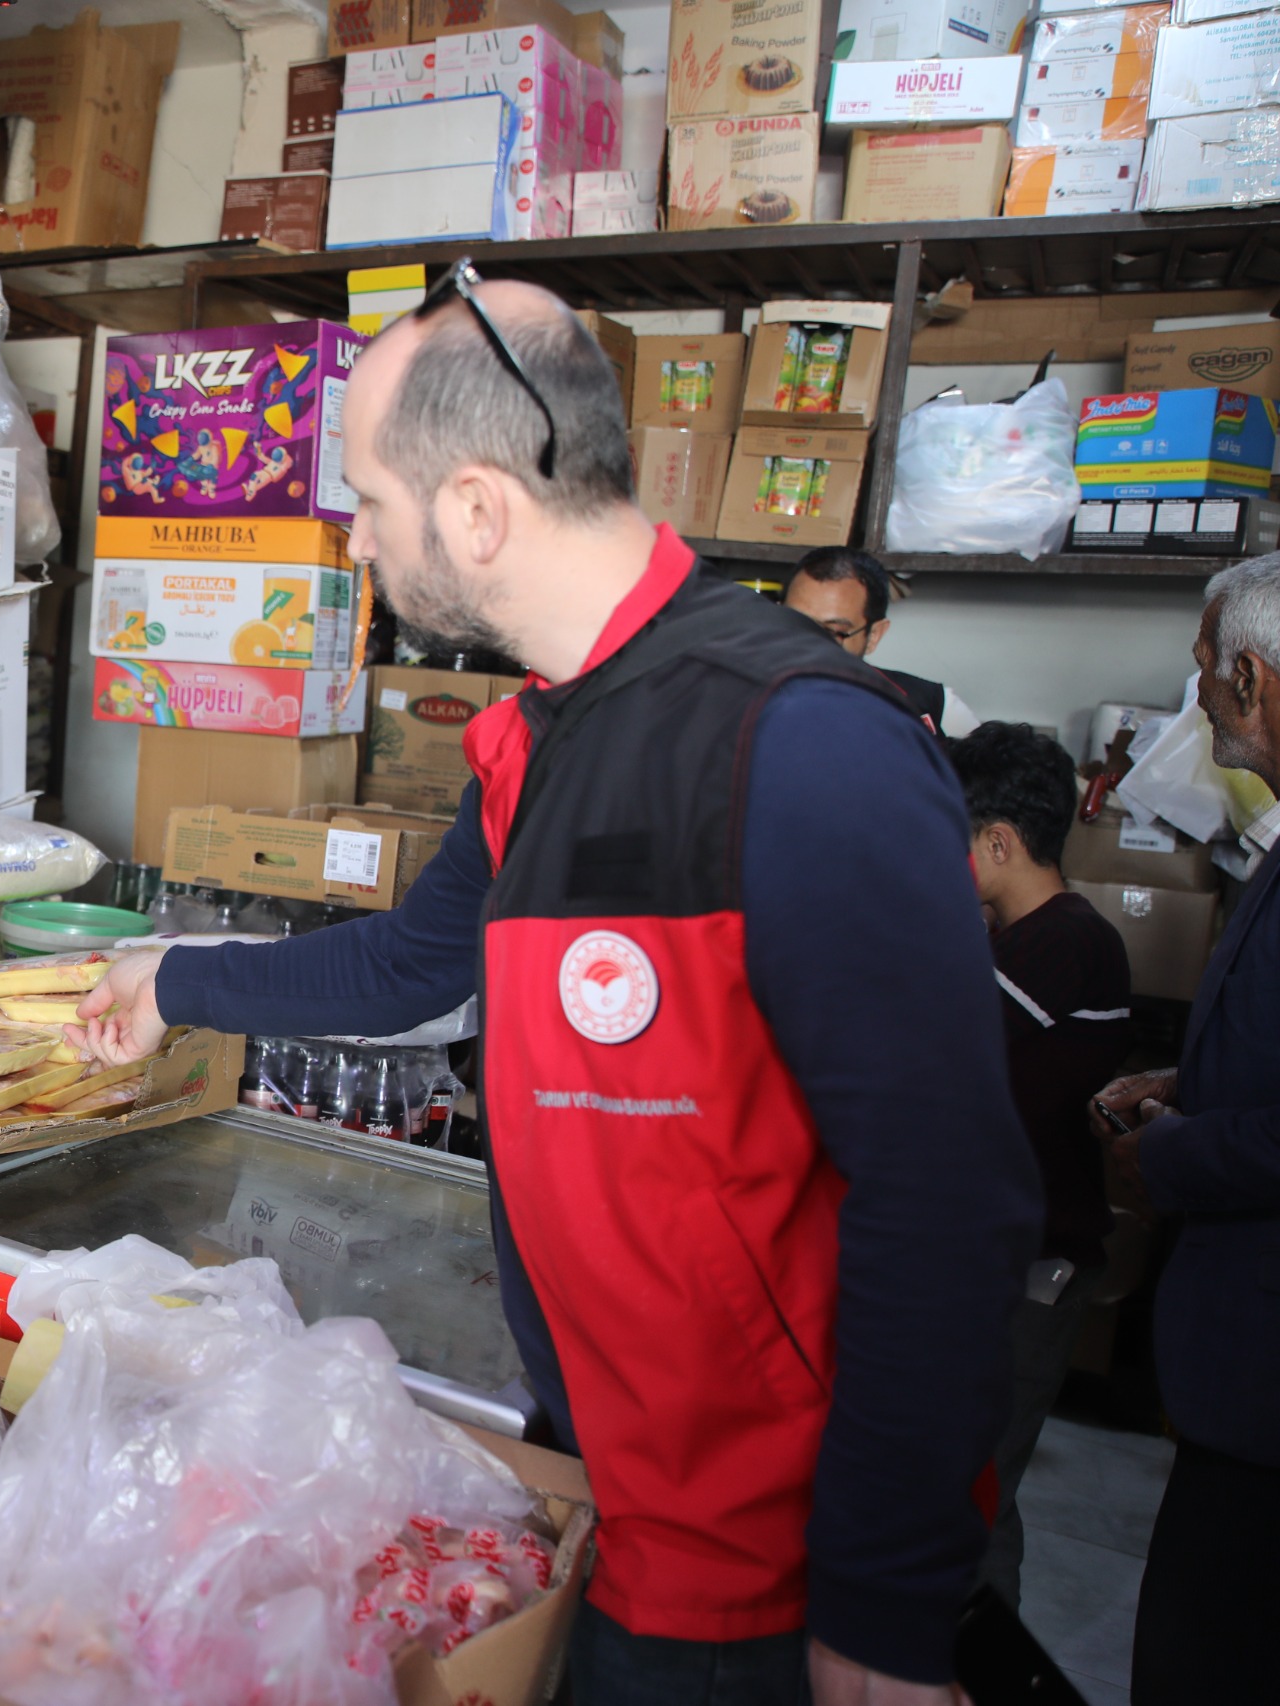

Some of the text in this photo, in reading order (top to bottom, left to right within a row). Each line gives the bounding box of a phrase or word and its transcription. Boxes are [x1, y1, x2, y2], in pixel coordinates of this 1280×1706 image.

[1232, 23, 1254, 33] GLOBAL
[731, 36, 806, 49] Baking Powder
[895, 67, 963, 93] HÜPJELİ
[738, 117, 801, 134] FUNDA
[730, 170, 803, 183] Baking Powder
[154, 348, 255, 398] LKZZ
[149, 402, 187, 420] Crispy
[1084, 395, 1152, 419] Indomie
[150, 524, 256, 544] MAHBUBA
[181, 544, 223, 554] ORANGE
[166, 577, 234, 591] PORTAKAL
[166, 679, 244, 714] HÜPJELİ
[417, 702, 469, 718] ALKAN
[533, 1089, 570, 1108] TARIM
[572, 1091, 588, 1108] VE
